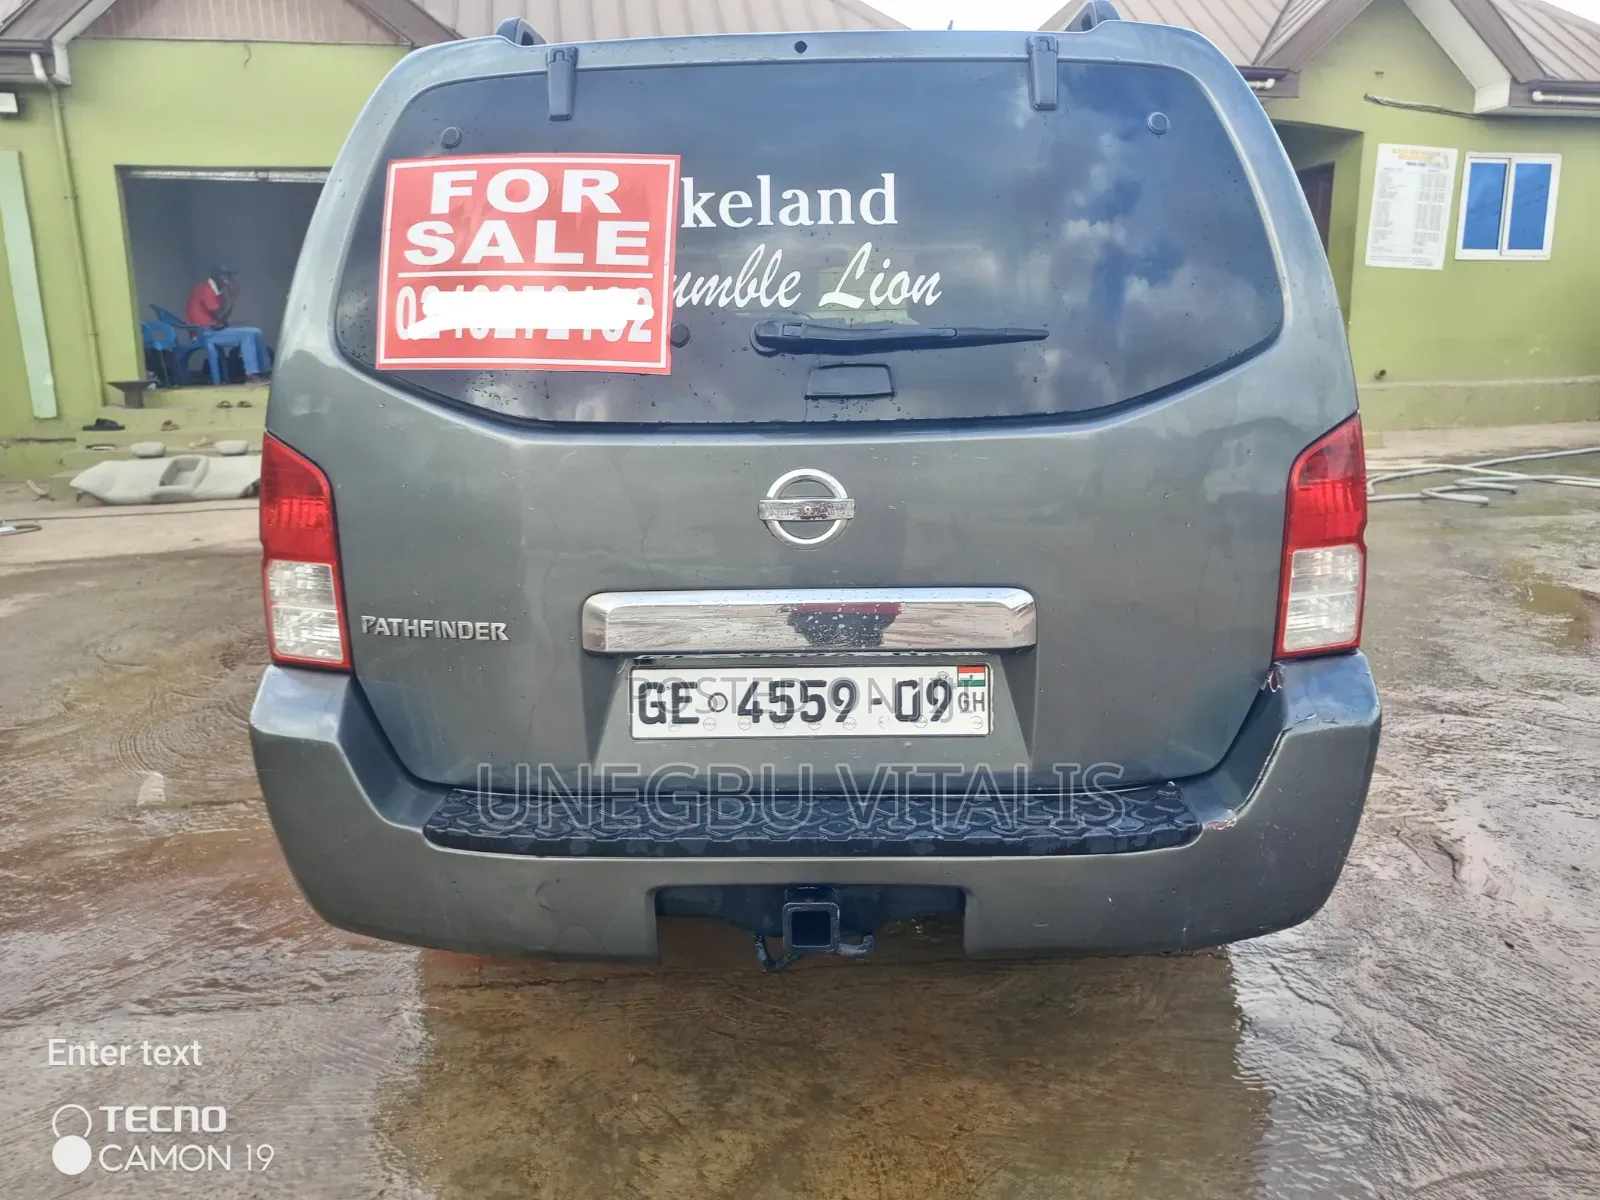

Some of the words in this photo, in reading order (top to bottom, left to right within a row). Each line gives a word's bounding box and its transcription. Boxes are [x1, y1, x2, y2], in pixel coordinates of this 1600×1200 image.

[431, 168, 621, 214] FOR
[403, 219, 649, 267] SALE
[818, 241, 942, 309] Lion
[361, 615, 510, 641] PATHFINDER
[638, 681, 700, 724] GE
[957, 691, 986, 713] GH
